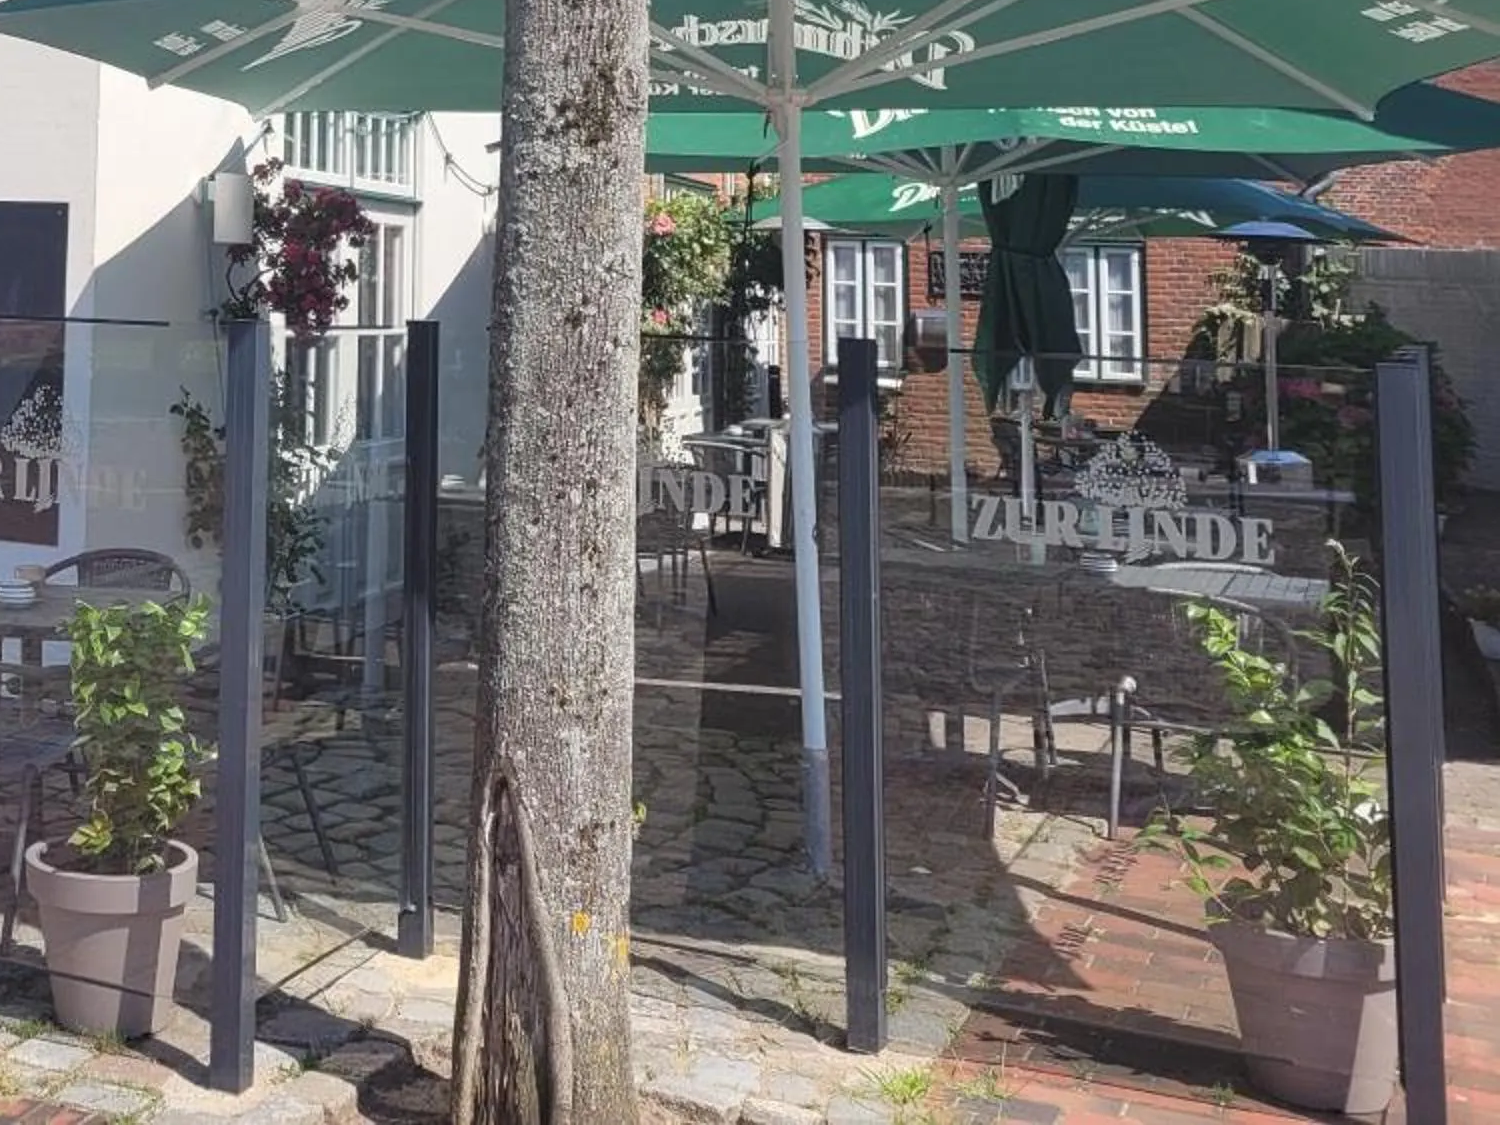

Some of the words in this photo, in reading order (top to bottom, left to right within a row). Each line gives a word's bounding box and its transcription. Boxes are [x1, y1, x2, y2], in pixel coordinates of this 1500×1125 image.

[1059, 116, 1103, 130] der
[637, 466, 757, 517] INDE
[971, 494, 1084, 548] ZUR
[1094, 503, 1276, 565] LINDE
